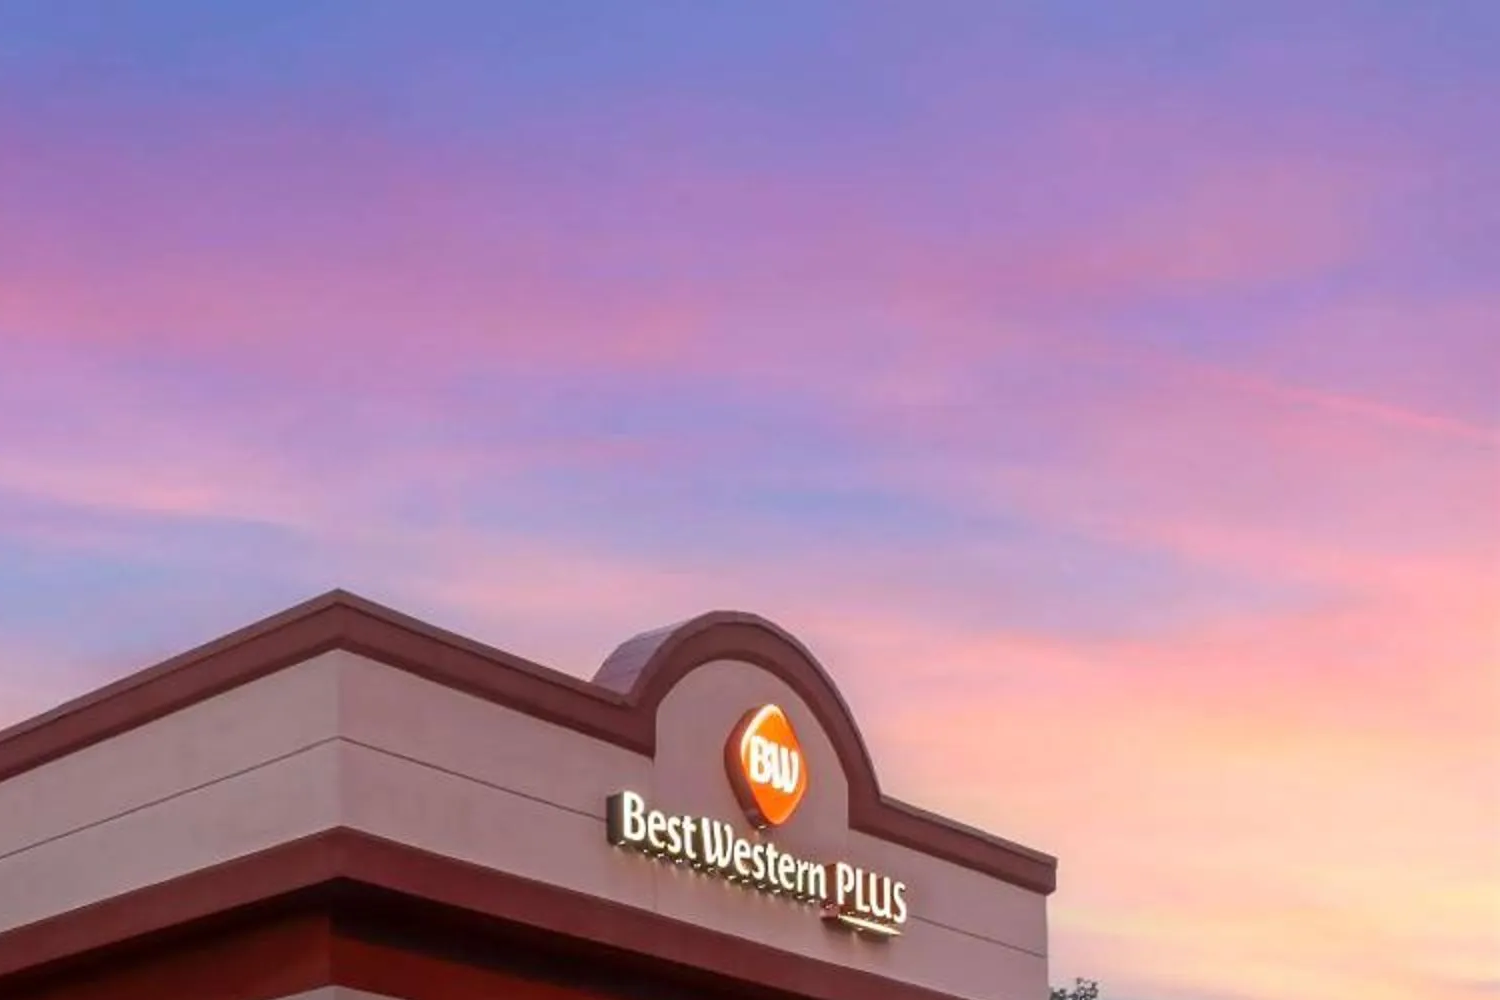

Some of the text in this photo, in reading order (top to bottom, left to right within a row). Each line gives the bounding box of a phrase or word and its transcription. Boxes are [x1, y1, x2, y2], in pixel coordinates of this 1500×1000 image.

[750, 735, 799, 793] BW
[622, 790, 908, 924] Best Western PLUS
